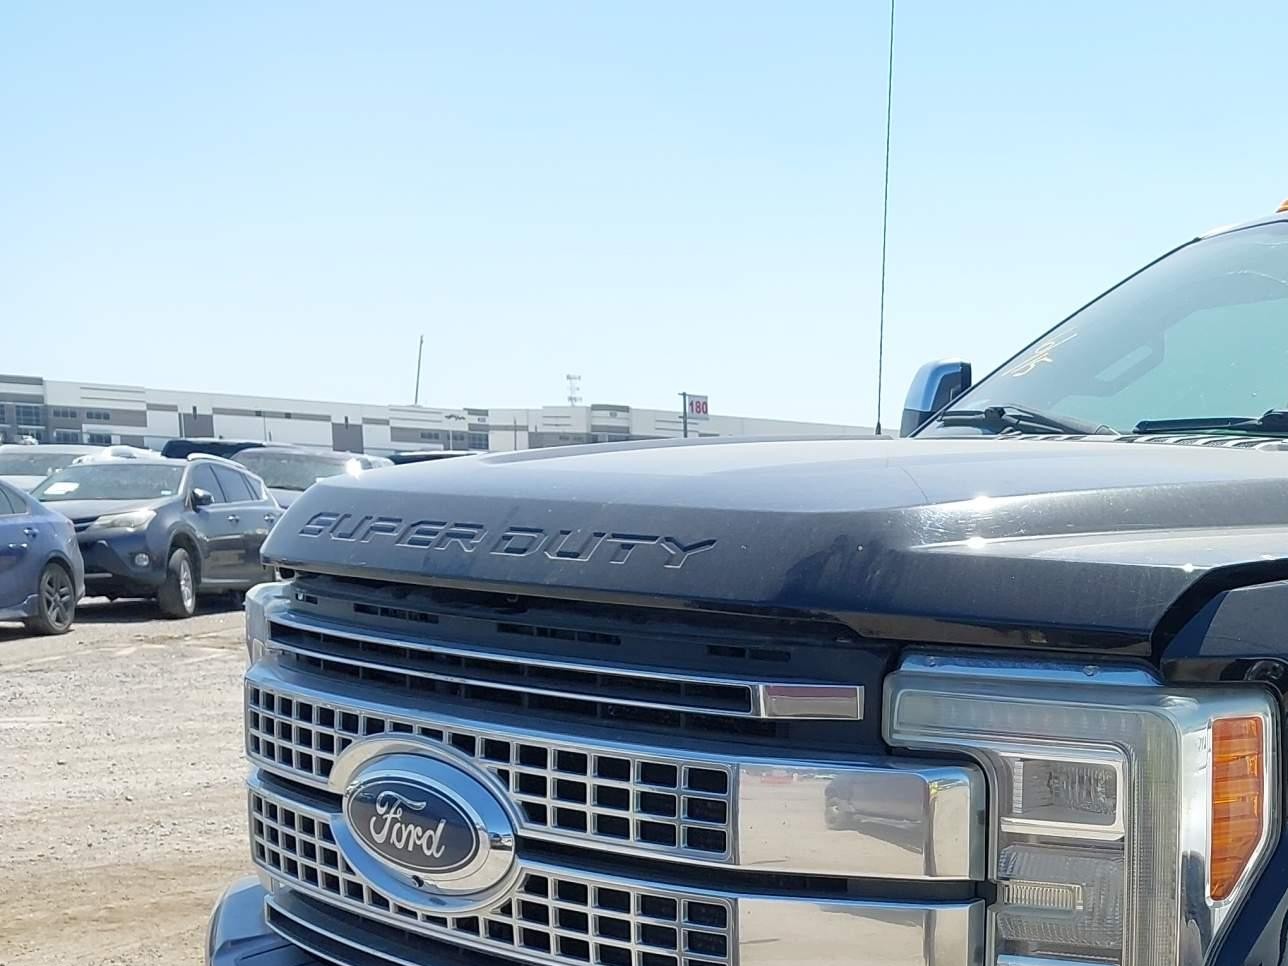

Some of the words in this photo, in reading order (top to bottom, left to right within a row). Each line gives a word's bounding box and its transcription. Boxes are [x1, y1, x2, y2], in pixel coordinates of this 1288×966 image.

[689, 399, 708, 415] 180
[298, 511, 489, 553] SUPER
[489, 526, 718, 569] DUTY
[370, 790, 447, 858] Ford
